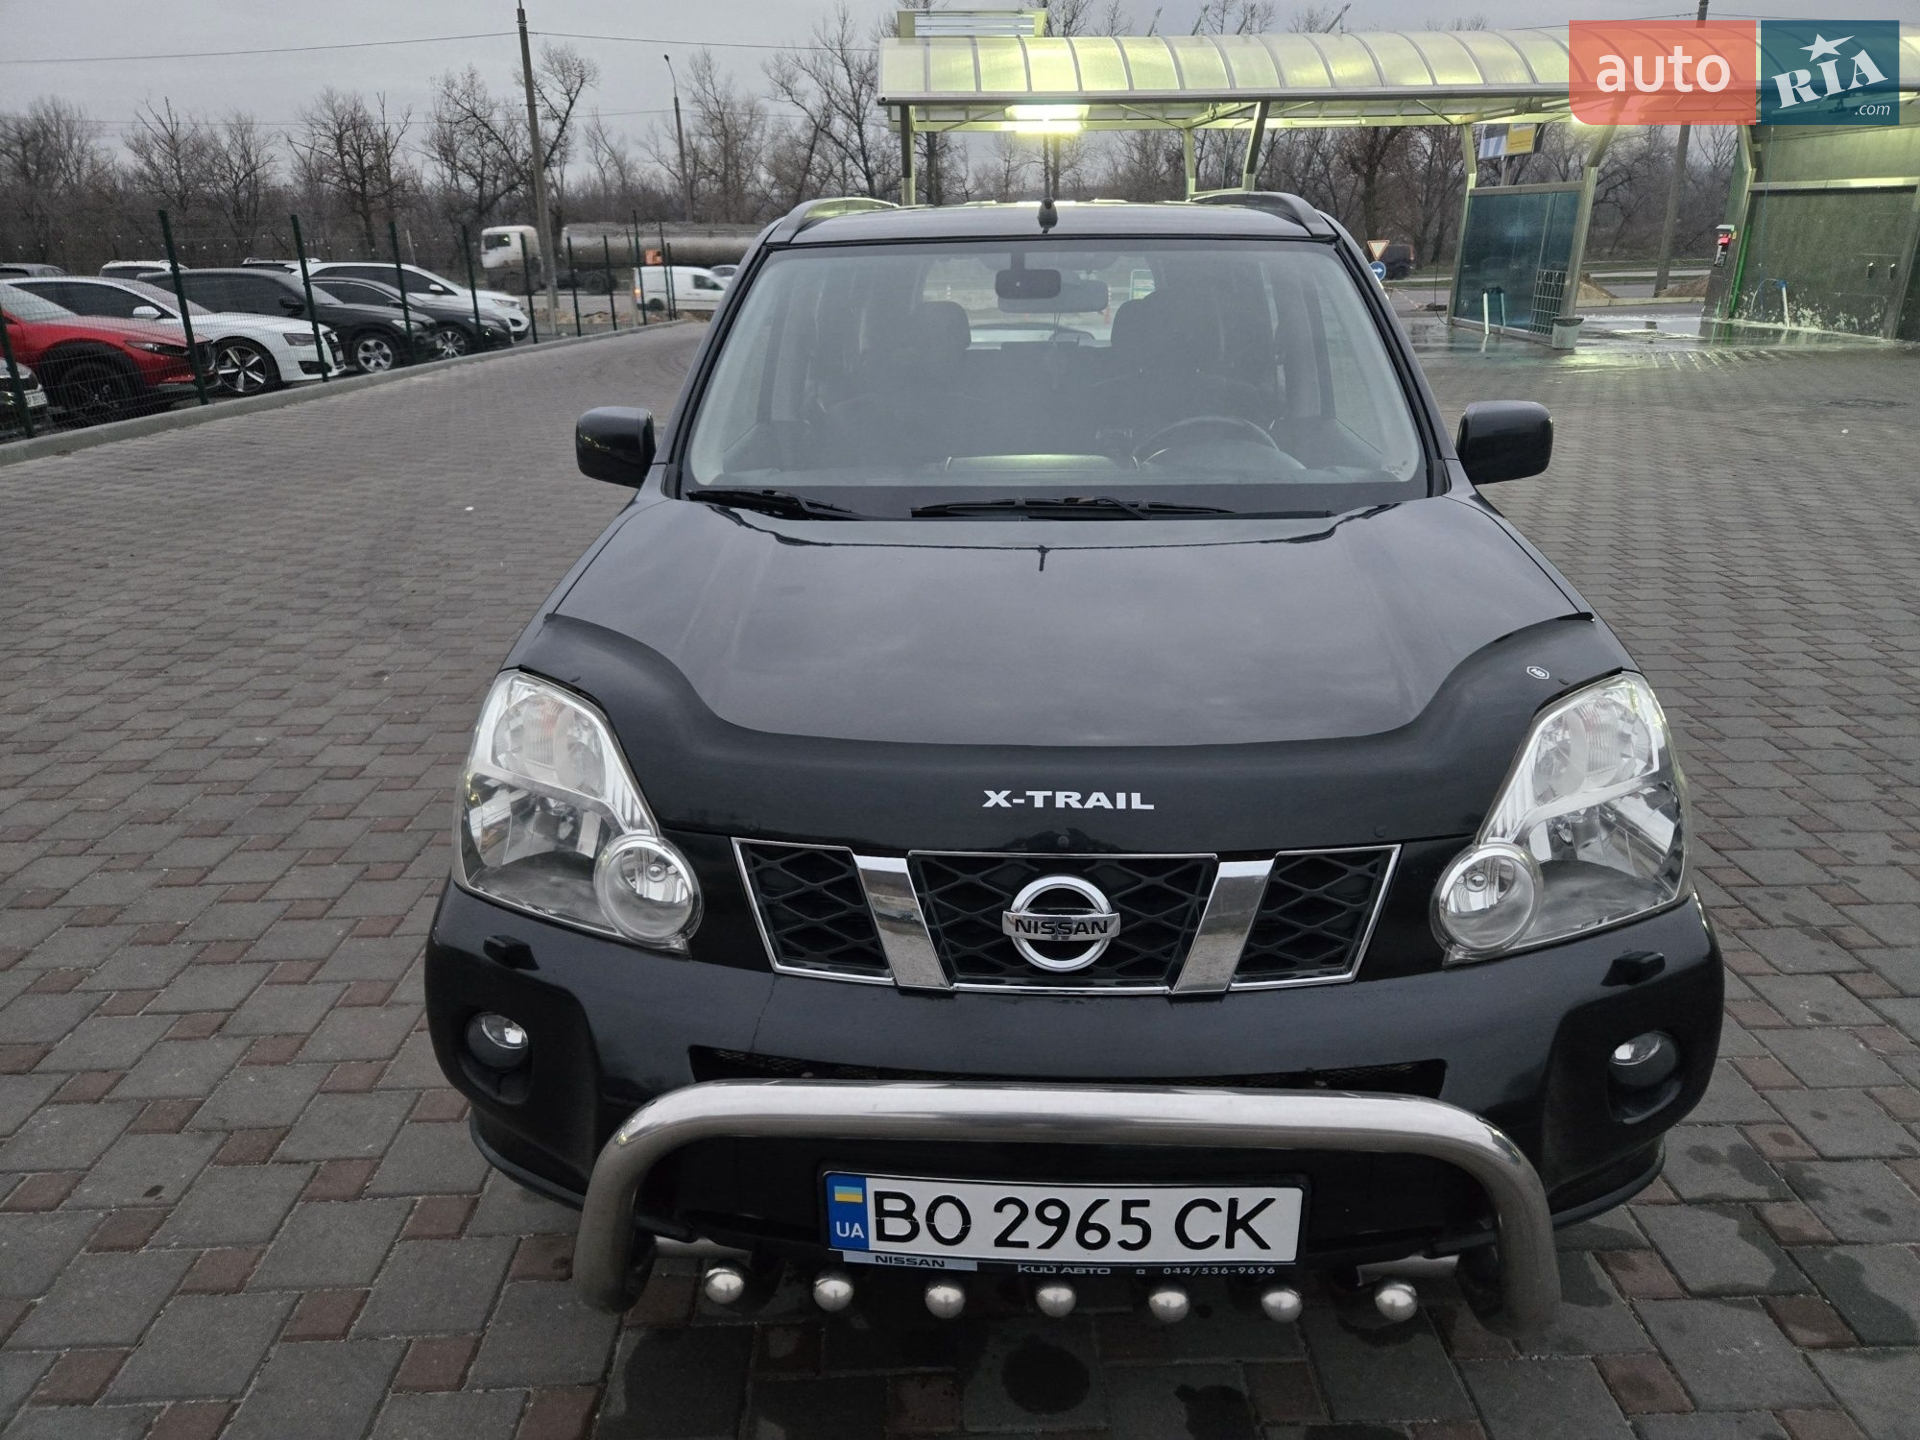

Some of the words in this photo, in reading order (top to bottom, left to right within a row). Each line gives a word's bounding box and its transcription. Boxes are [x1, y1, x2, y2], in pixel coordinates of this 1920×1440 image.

[982, 790, 1155, 810] X-TRAIL
[1015, 919, 1108, 935] NISSAN
[874, 1190, 972, 1246] BO
[993, 1197, 1152, 1251] 2965
[1174, 1198, 1277, 1250] CK
[836, 1221, 865, 1239] UA
[875, 1255, 945, 1268] NISSAN
[1163, 1266, 1276, 1276] 044/536-9696
